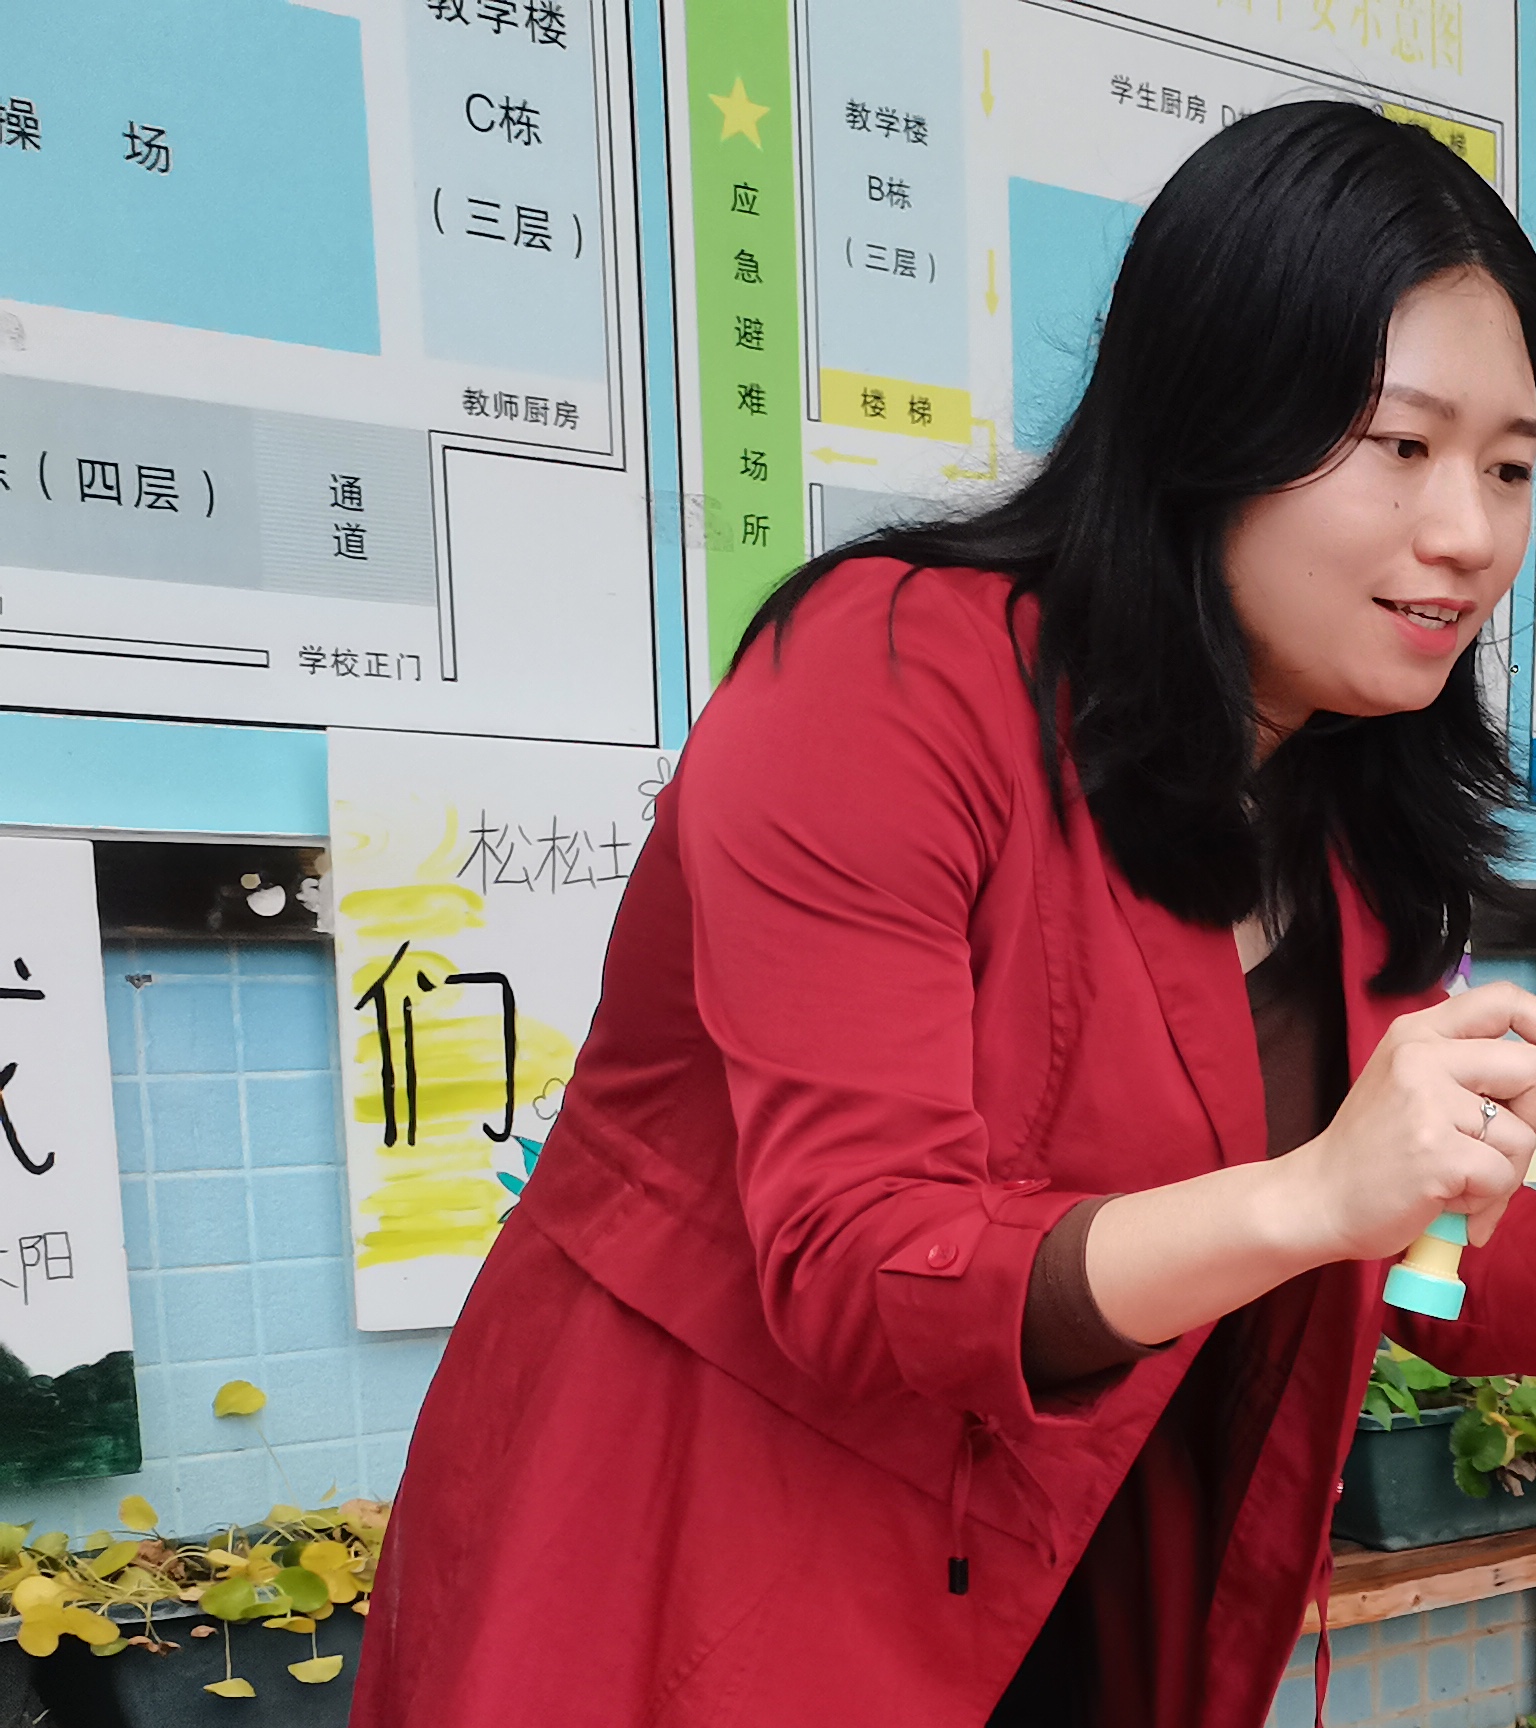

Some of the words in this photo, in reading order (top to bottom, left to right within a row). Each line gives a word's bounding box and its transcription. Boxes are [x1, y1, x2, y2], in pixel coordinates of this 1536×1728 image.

[466, 93, 542, 146] C栋
[845, 98, 929, 147] 教学楼
[1109, 74, 1207, 126] 学生厨房
[867, 174, 913, 211] B栋
[433, 187, 582, 260] （三层）
[846, 236, 936, 284] （三层）
[731, 181, 771, 549] 应急避难场所
[462, 387, 580, 431] 教师厨房
[860, 387, 933, 428] 楼梯
[329, 473, 369, 561] 通道
[298, 645, 422, 682] 学校正门
[456, 808, 632, 896] 松松土
[354, 940, 516, 1147] 们
